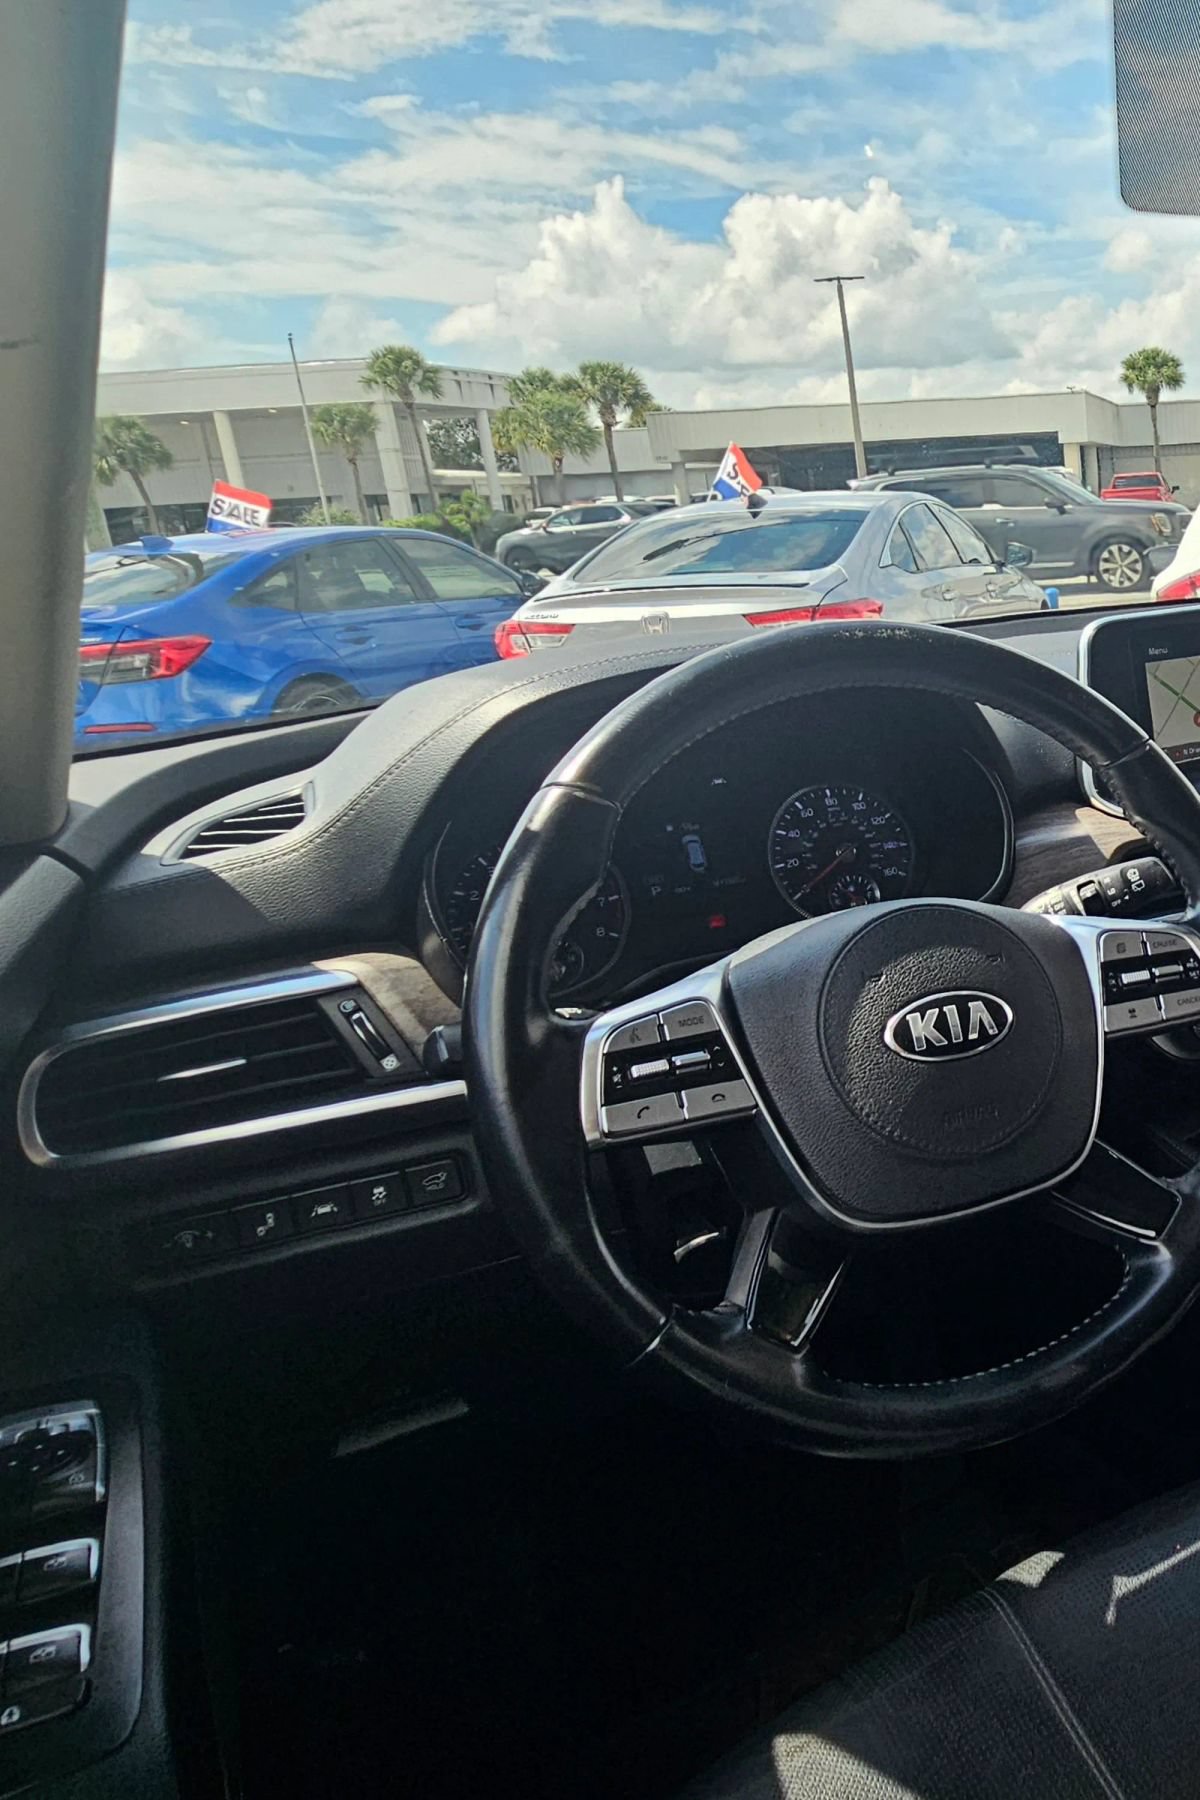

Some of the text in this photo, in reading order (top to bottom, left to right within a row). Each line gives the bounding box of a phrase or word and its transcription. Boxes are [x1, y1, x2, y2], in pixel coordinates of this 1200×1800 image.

[1148, 647, 1168, 655] Menu
[824, 797, 838, 806] 80
[852, 801, 866, 811] 100
[801, 808, 814, 818] 60
[870, 816, 886, 825] 120
[787, 829, 800, 838] 40
[786, 858, 799, 868] 20
[469, 890, 479, 901] 2
[678, 1016, 705, 1028] MODE
[906, 1000, 999, 1052] KIA
